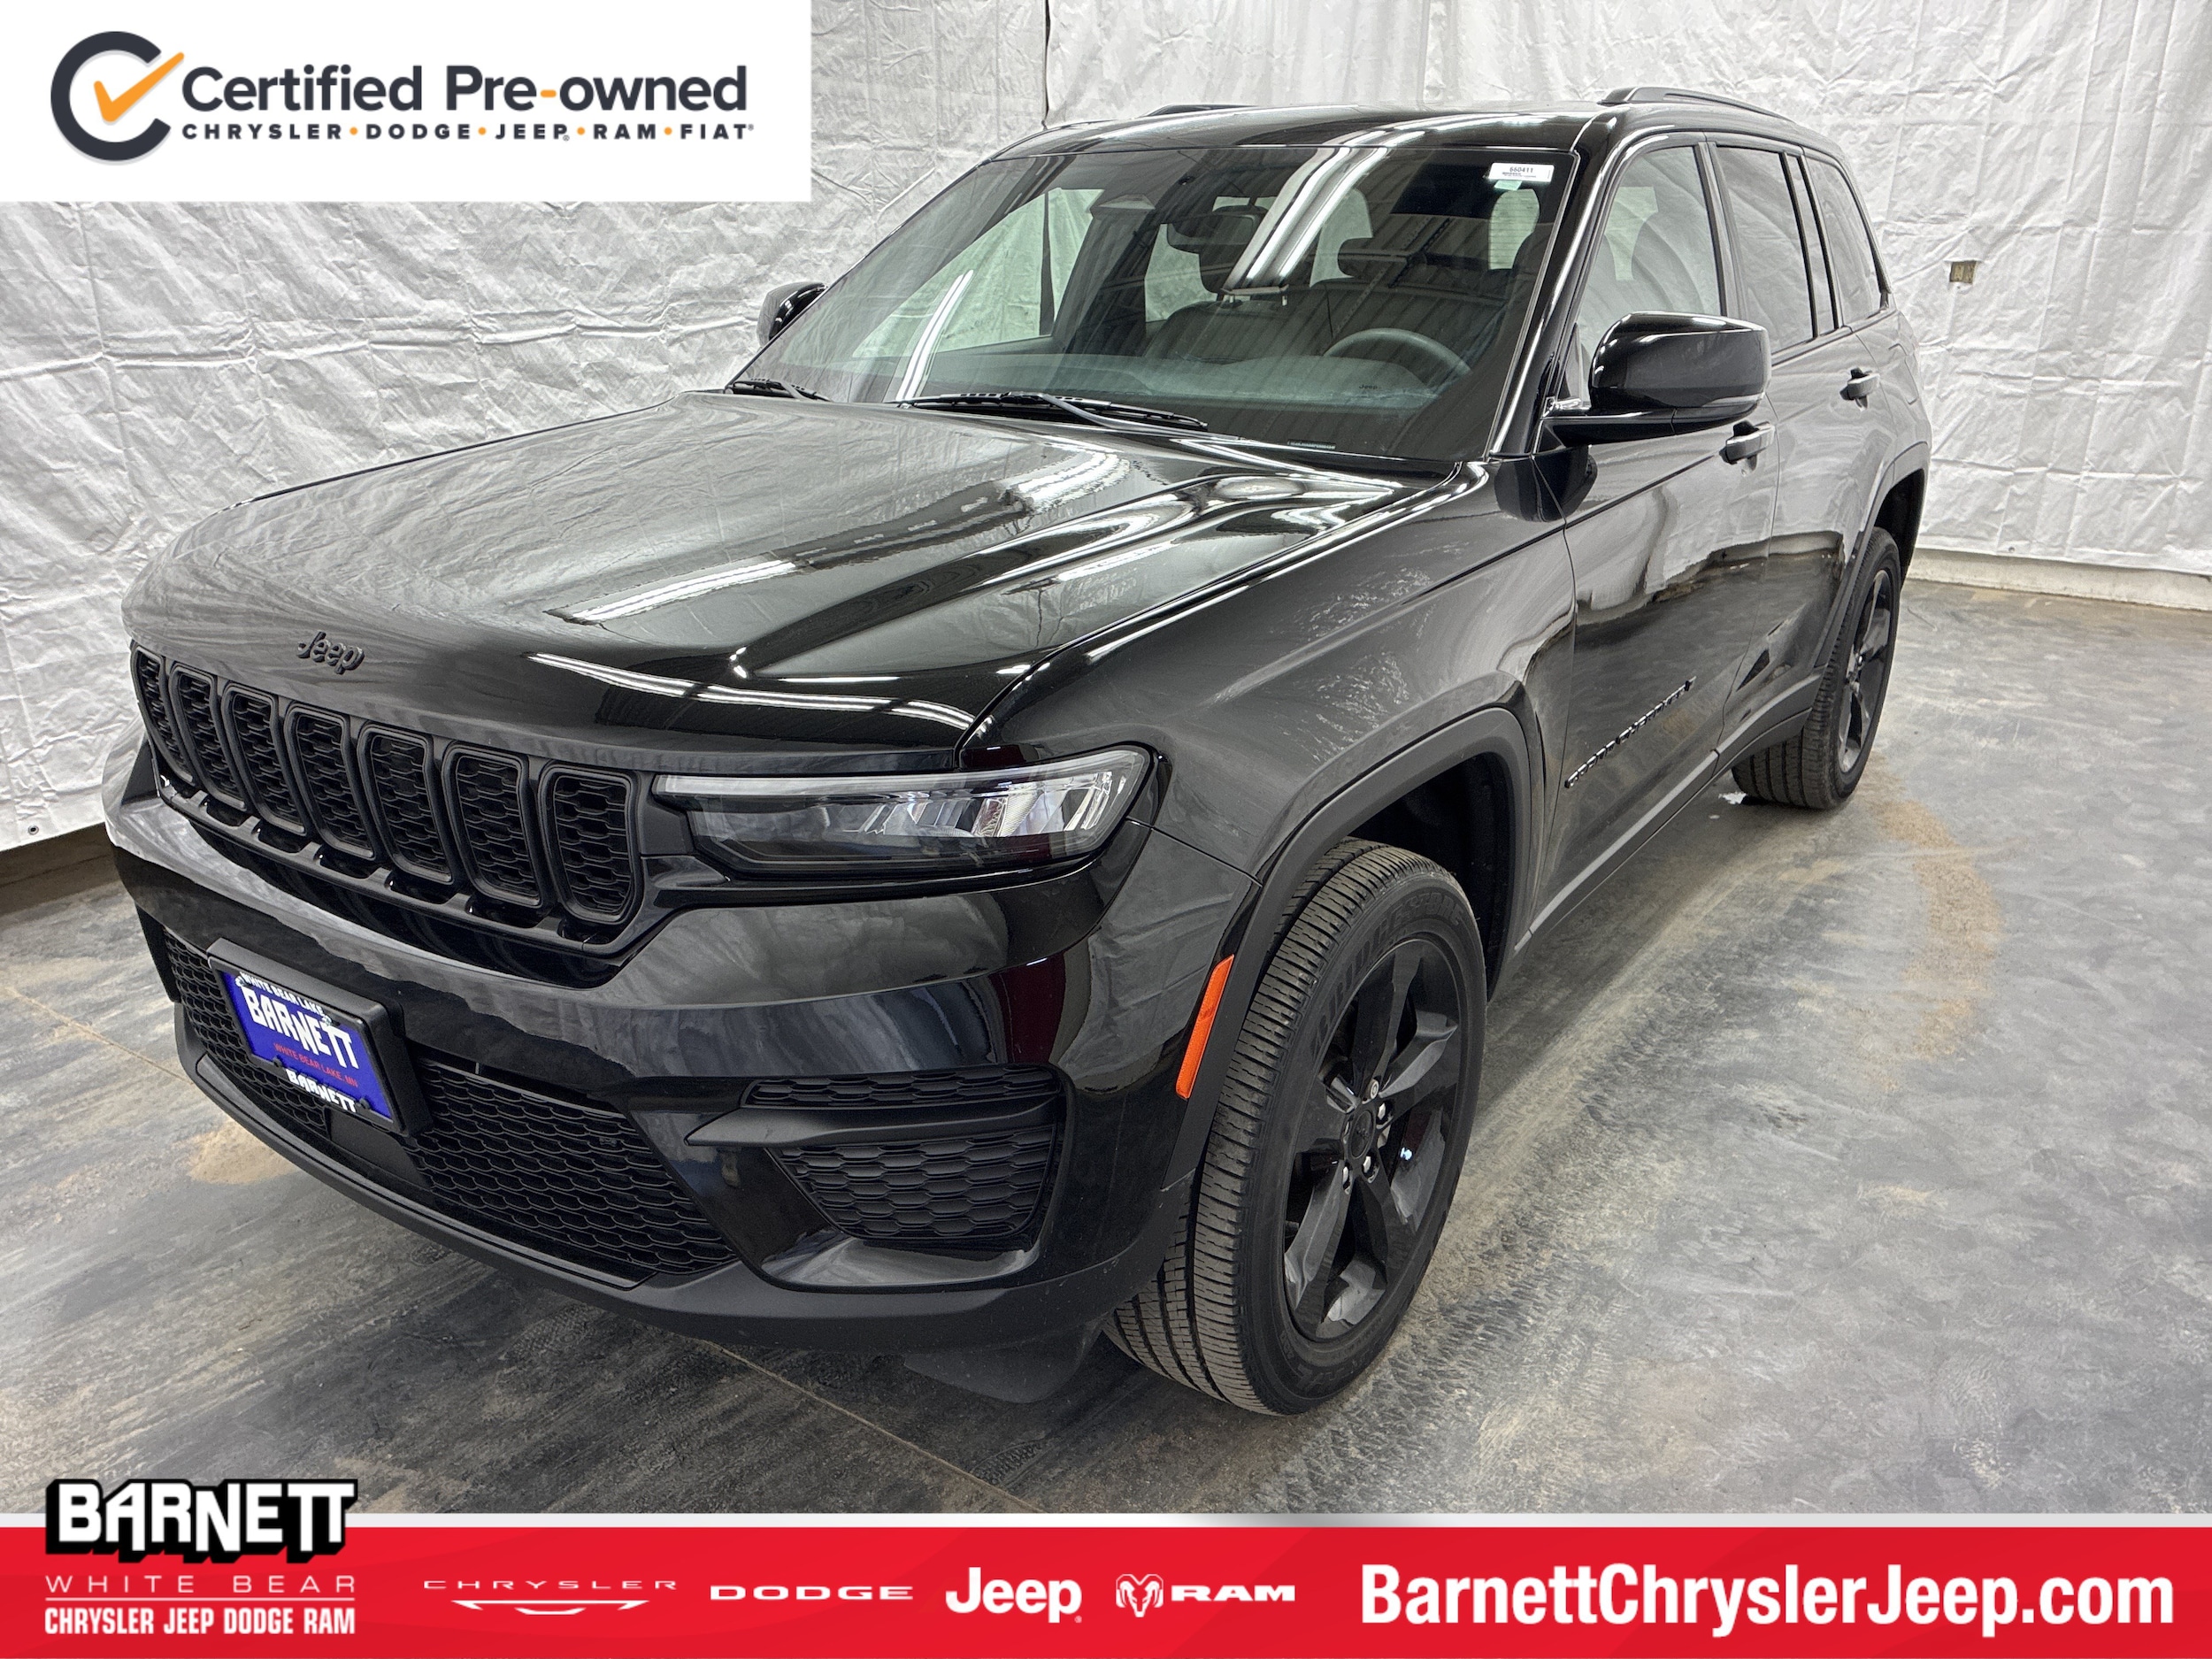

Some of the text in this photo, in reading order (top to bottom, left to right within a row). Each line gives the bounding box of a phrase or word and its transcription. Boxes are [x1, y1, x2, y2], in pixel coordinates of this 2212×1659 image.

[296, 630, 365, 675] Jeep
[239, 972, 326, 1018] WHITE BEAR LAKE
[241, 985, 358, 1070] BARNETT
[285, 1067, 356, 1113] BARNETT
